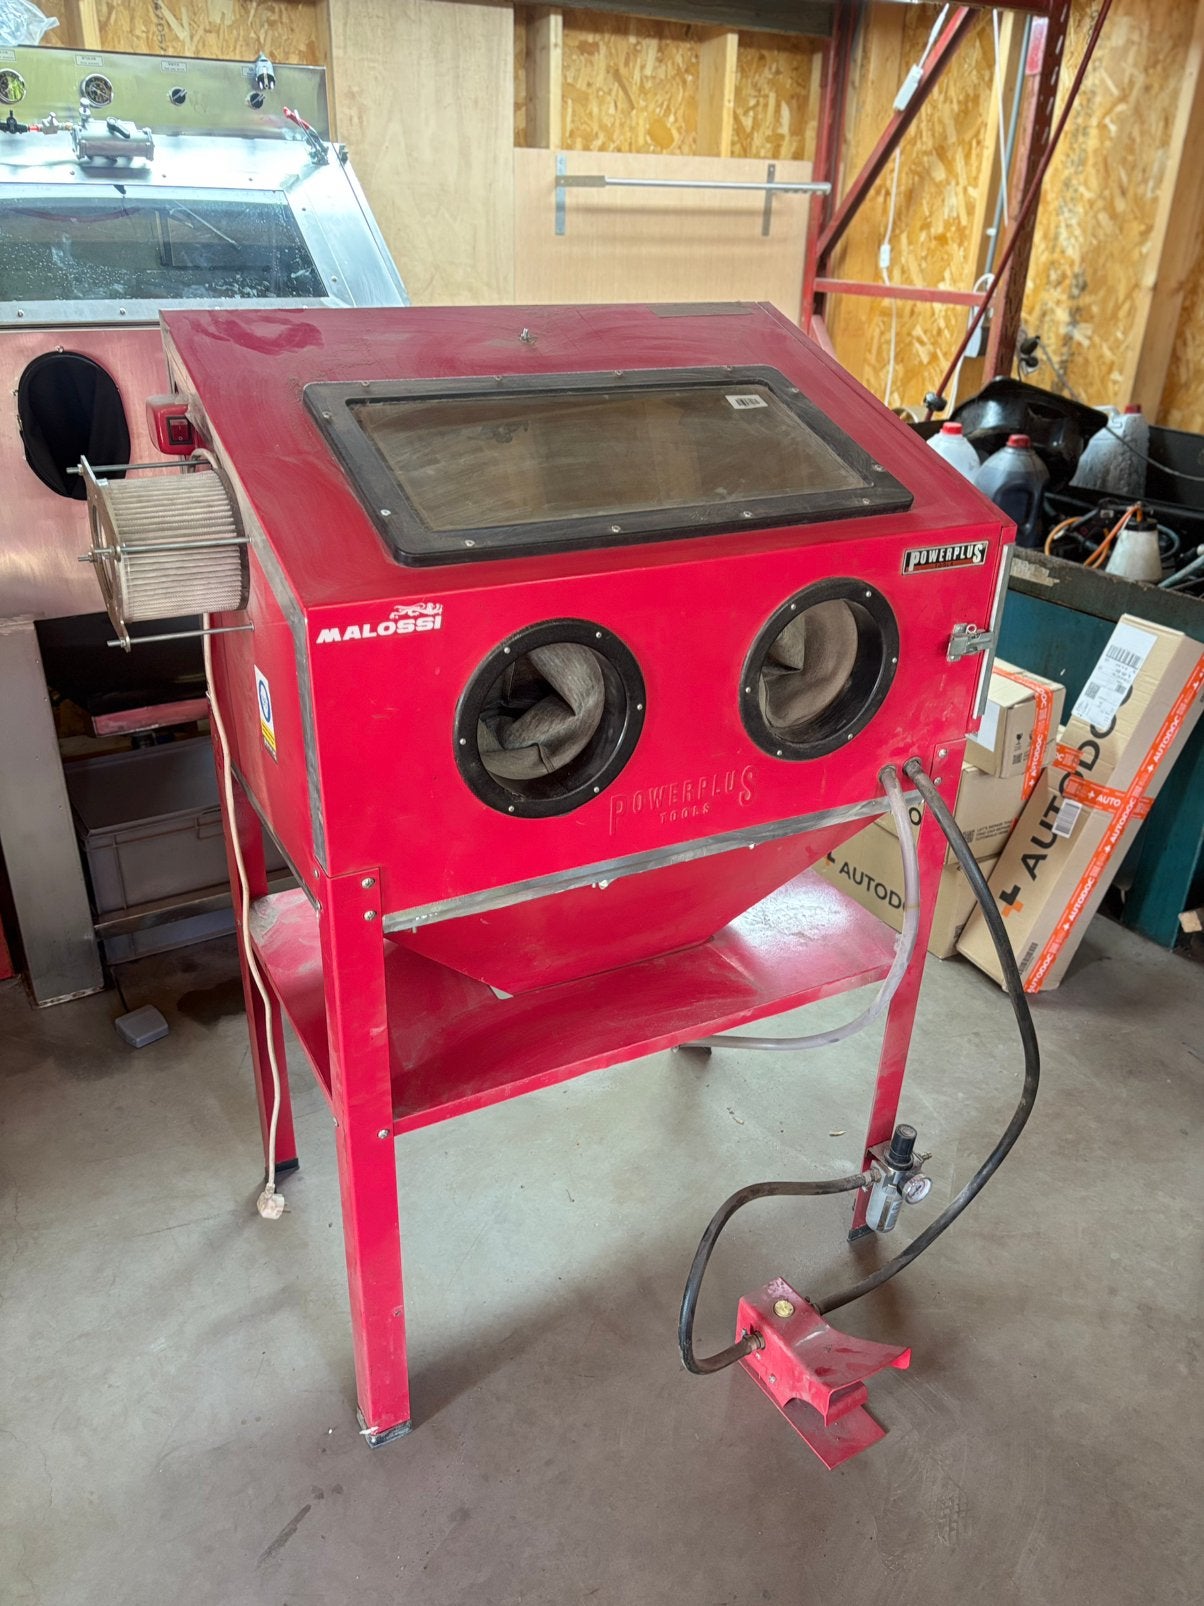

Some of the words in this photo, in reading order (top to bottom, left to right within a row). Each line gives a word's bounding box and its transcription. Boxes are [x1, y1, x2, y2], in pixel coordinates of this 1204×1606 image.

[908, 543, 983, 572] POWERPLUS
[316, 616, 442, 644] MALOSSI
[1153, 716, 1181, 763] AUTODOC
[609, 765, 754, 837] POWERPLUS
[660, 802, 711, 825] TOOLS
[1096, 793, 1122, 808] AUTO
[1110, 798, 1137, 843] AUTODOC
[838, 861, 905, 911] AUTOD
[1068, 877, 1095, 921] AUTODOC
